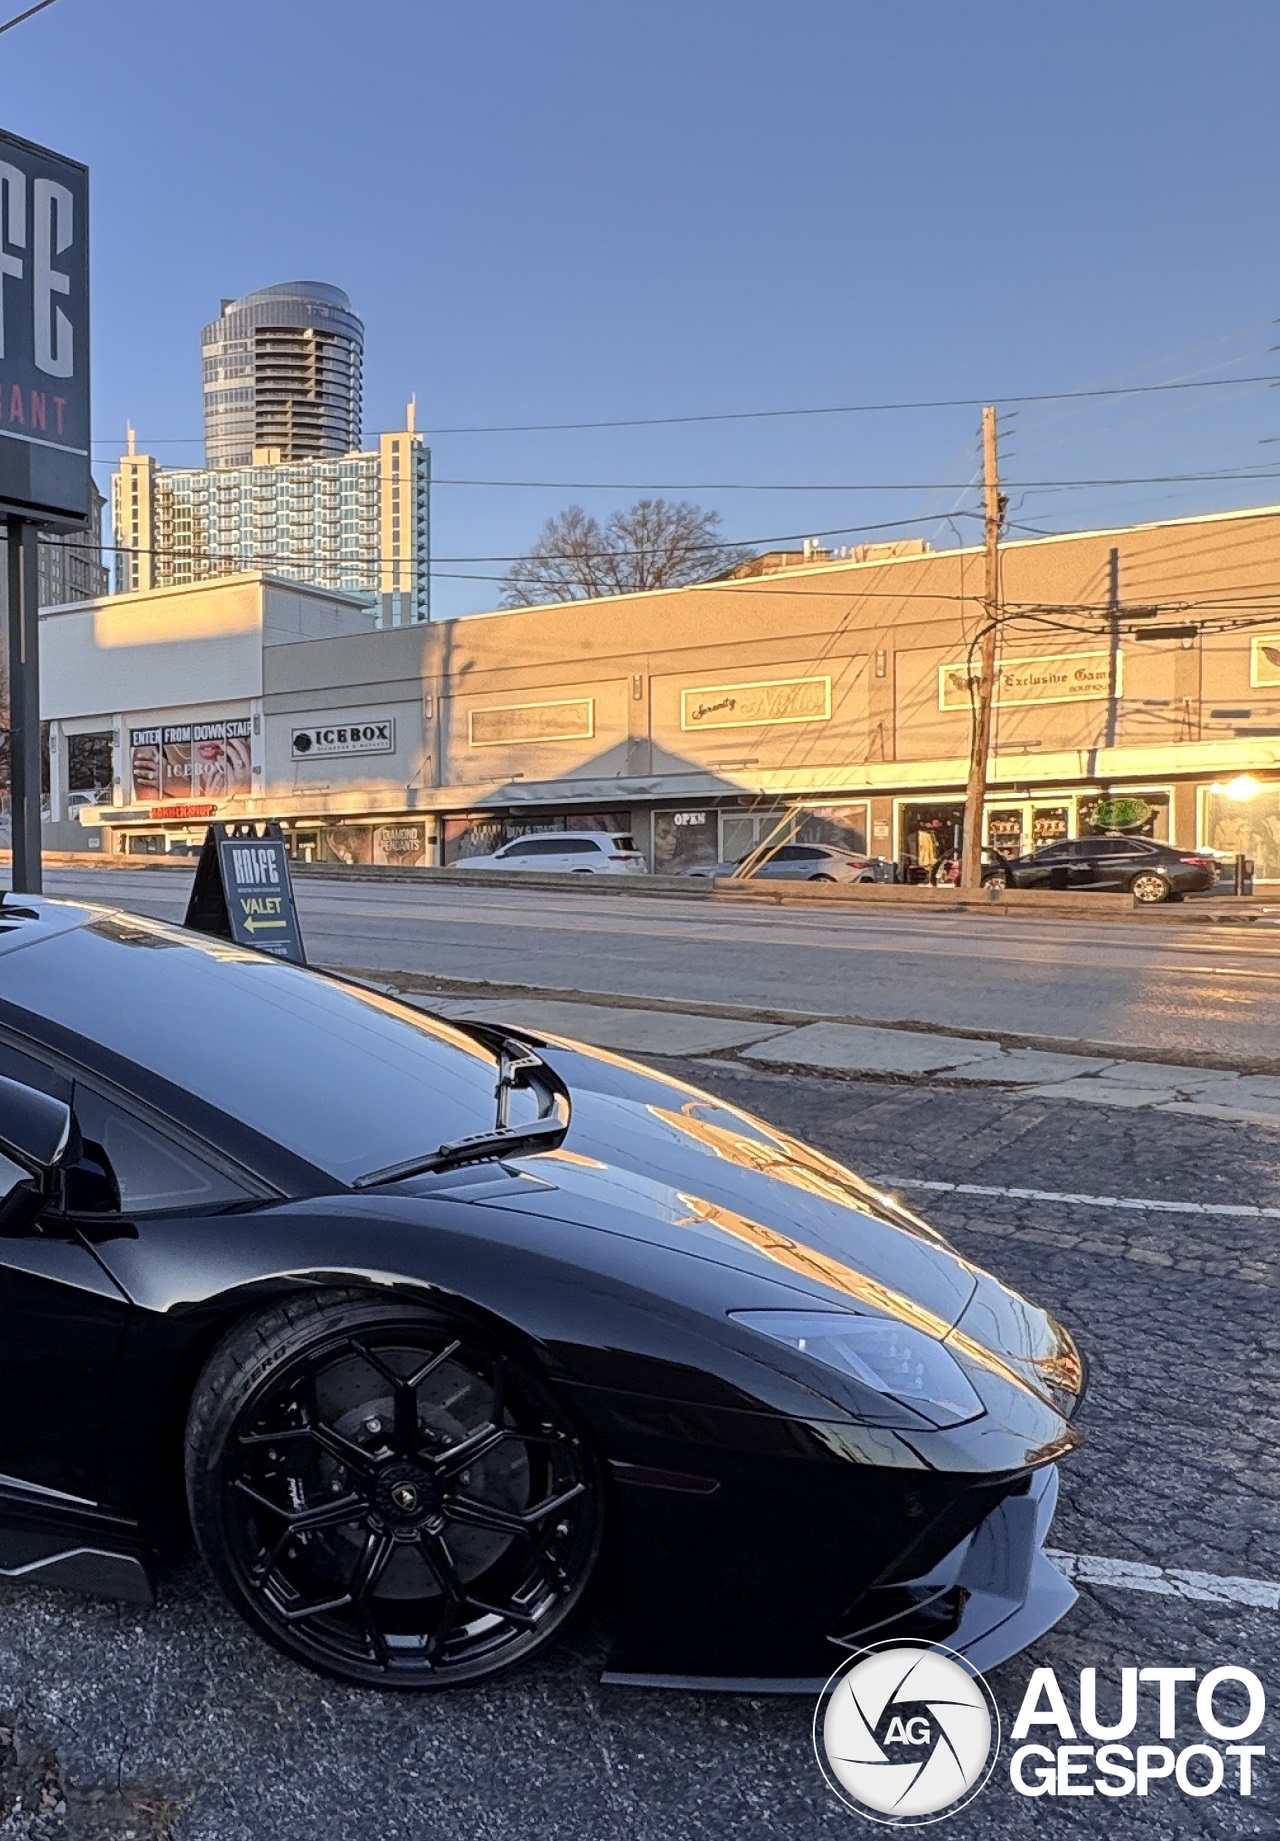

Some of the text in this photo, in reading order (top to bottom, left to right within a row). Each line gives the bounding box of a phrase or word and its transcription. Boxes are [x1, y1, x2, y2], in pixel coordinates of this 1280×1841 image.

[1003, 673, 1068, 691] Exclusive
[133, 729, 160, 746] ENTER
[164, 726, 191, 743] FROM
[315, 724, 389, 746] ICEBOX
[673, 812, 706, 826] OPEN
[382, 828, 418, 840] DIAMOND
[380, 840, 420, 851] PENDANTS
[233, 848, 280, 884] KNIFE
[240, 897, 282, 915] VALET
